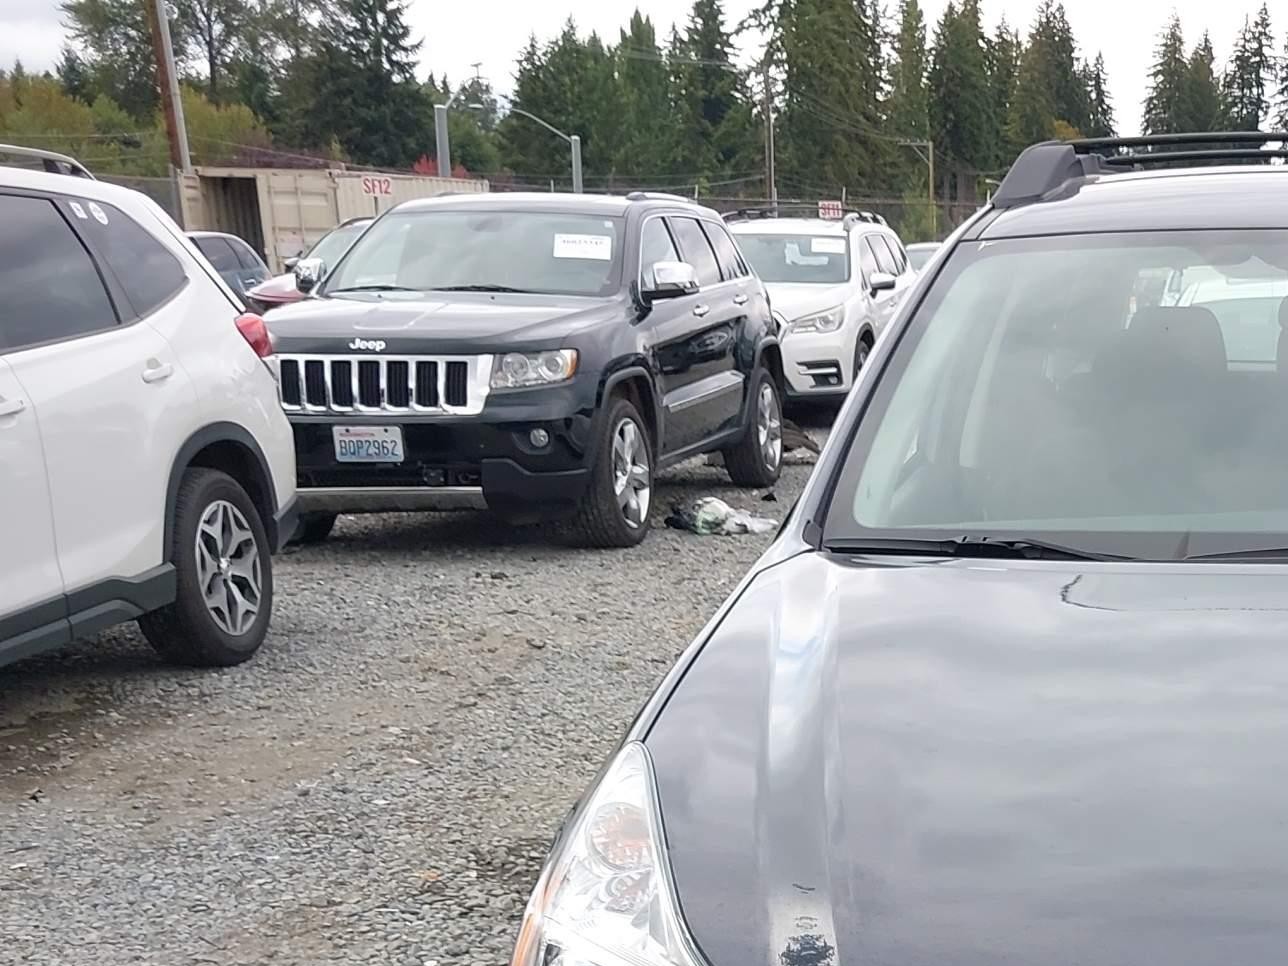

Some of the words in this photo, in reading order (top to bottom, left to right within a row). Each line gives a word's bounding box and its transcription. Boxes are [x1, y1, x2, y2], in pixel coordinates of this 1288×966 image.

[363, 177, 392, 195] SF12
[348, 337, 386, 352] Jeep
[339, 439, 400, 457] BQP2962
